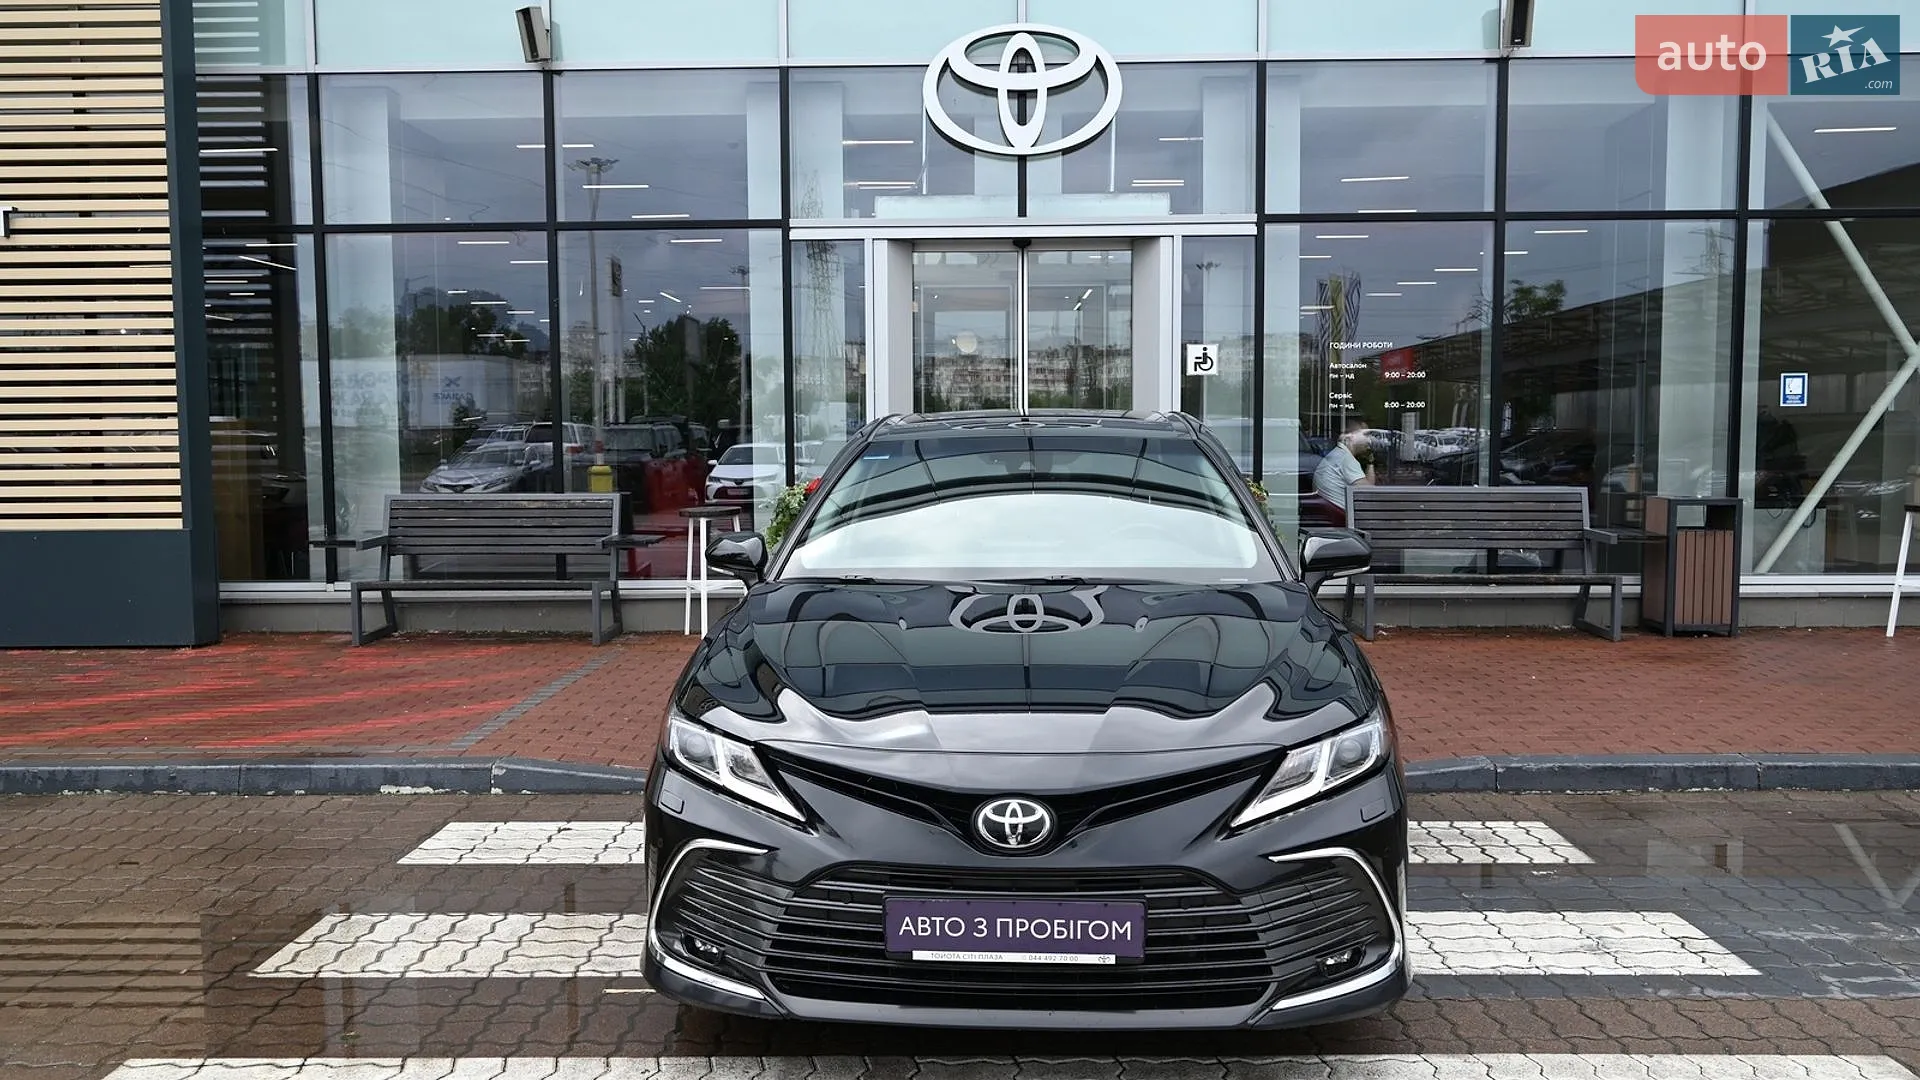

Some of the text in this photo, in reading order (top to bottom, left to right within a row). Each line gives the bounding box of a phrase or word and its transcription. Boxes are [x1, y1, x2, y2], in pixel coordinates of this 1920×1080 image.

[1329, 342, 1361, 350] ГОДИНИ
[1329, 392, 1352, 400] Сервіс
[1384, 401, 1400, 409] 8:00
[1406, 401, 1426, 409] 20:00
[899, 916, 1132, 941] АВТО З ПРОБІГОМ
[978, 953, 1004, 961] ПЛАЗА
